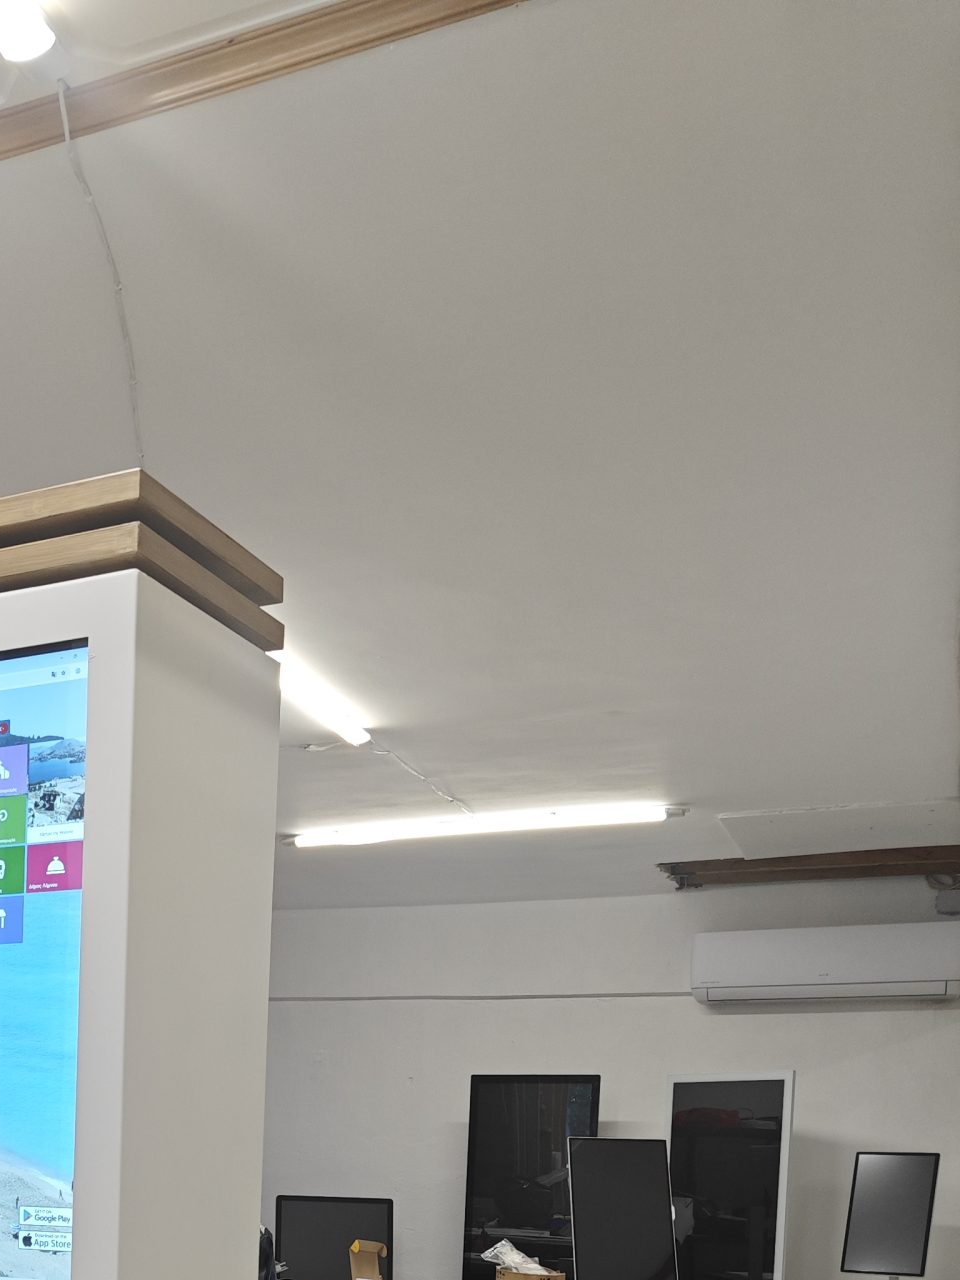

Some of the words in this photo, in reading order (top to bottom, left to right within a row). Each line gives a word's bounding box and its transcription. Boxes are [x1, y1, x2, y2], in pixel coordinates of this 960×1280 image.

[34, 1213, 57, 1224] Google
[57, 1215, 71, 1225] Play
[33, 1238, 49, 1249] App
[50, 1239, 72, 1249] Store
